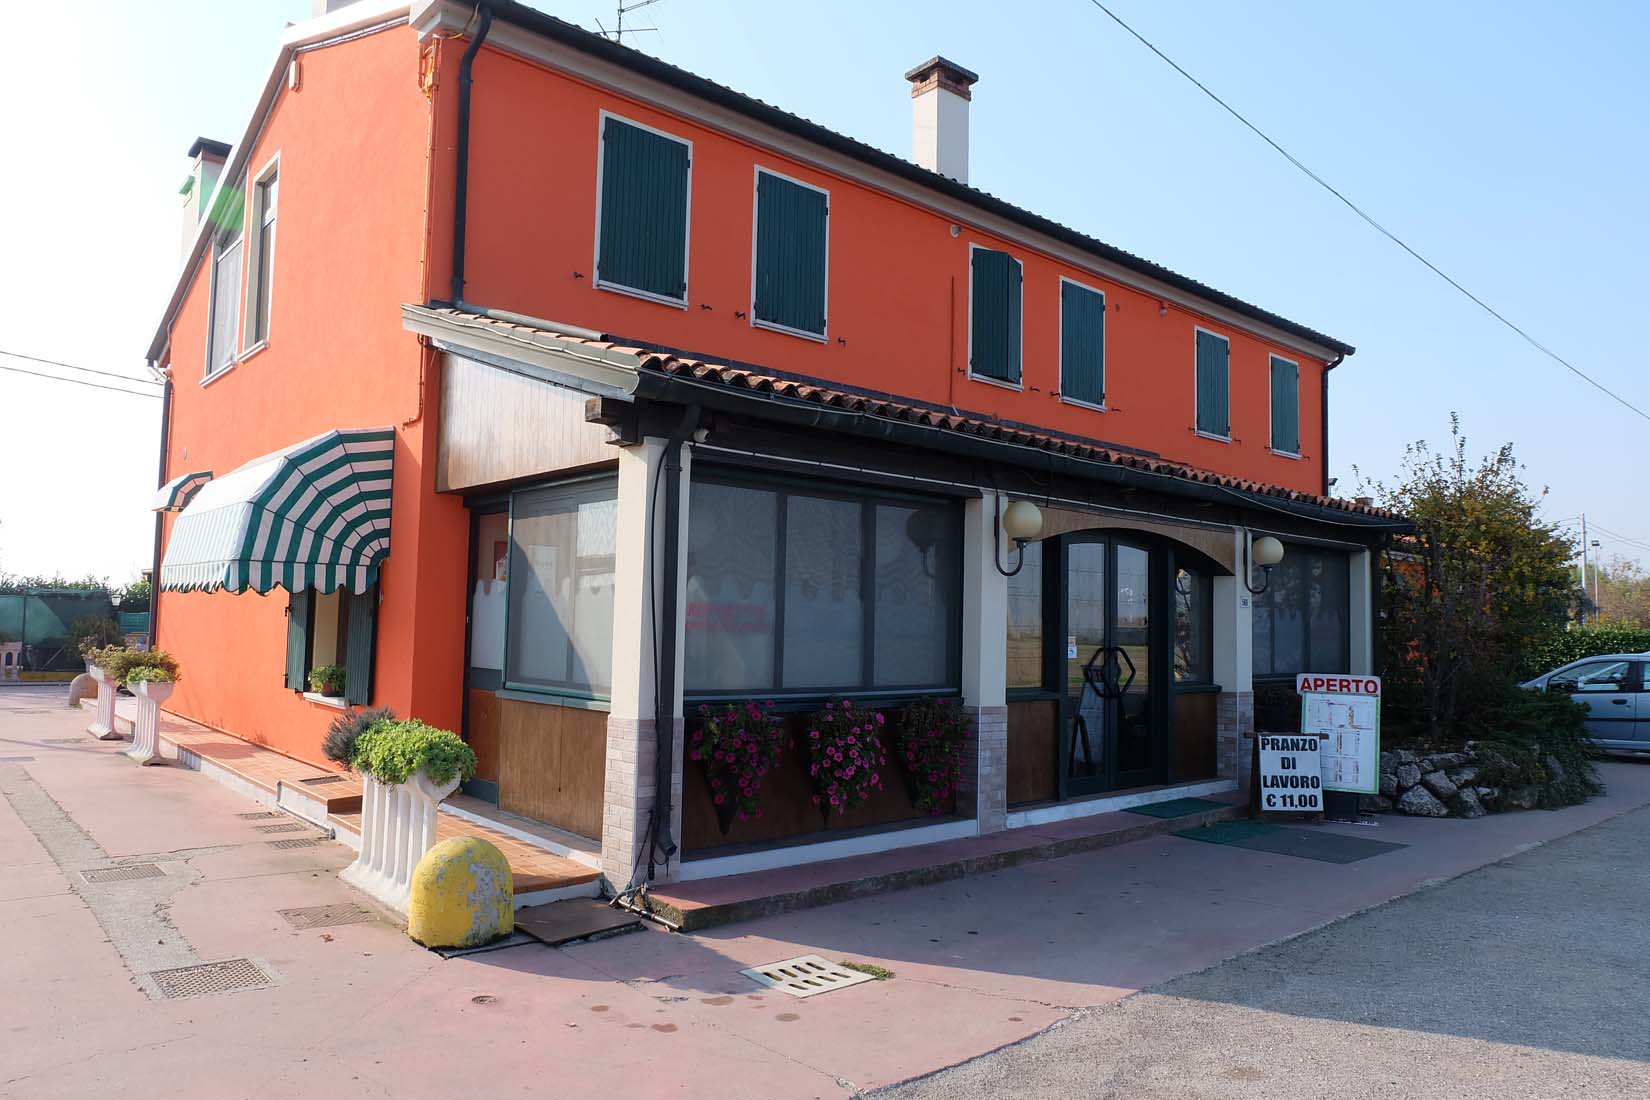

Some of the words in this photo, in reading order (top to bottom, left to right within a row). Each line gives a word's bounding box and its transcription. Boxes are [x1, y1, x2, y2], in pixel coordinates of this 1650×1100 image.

[1300, 677, 1378, 694] APERTO
[1261, 738, 1318, 752] PRANZO
[1281, 757, 1296, 770] DI
[1262, 776, 1320, 789] LAVORO
[1266, 794, 1276, 808] €
[1280, 794, 1318, 808] 11,00
